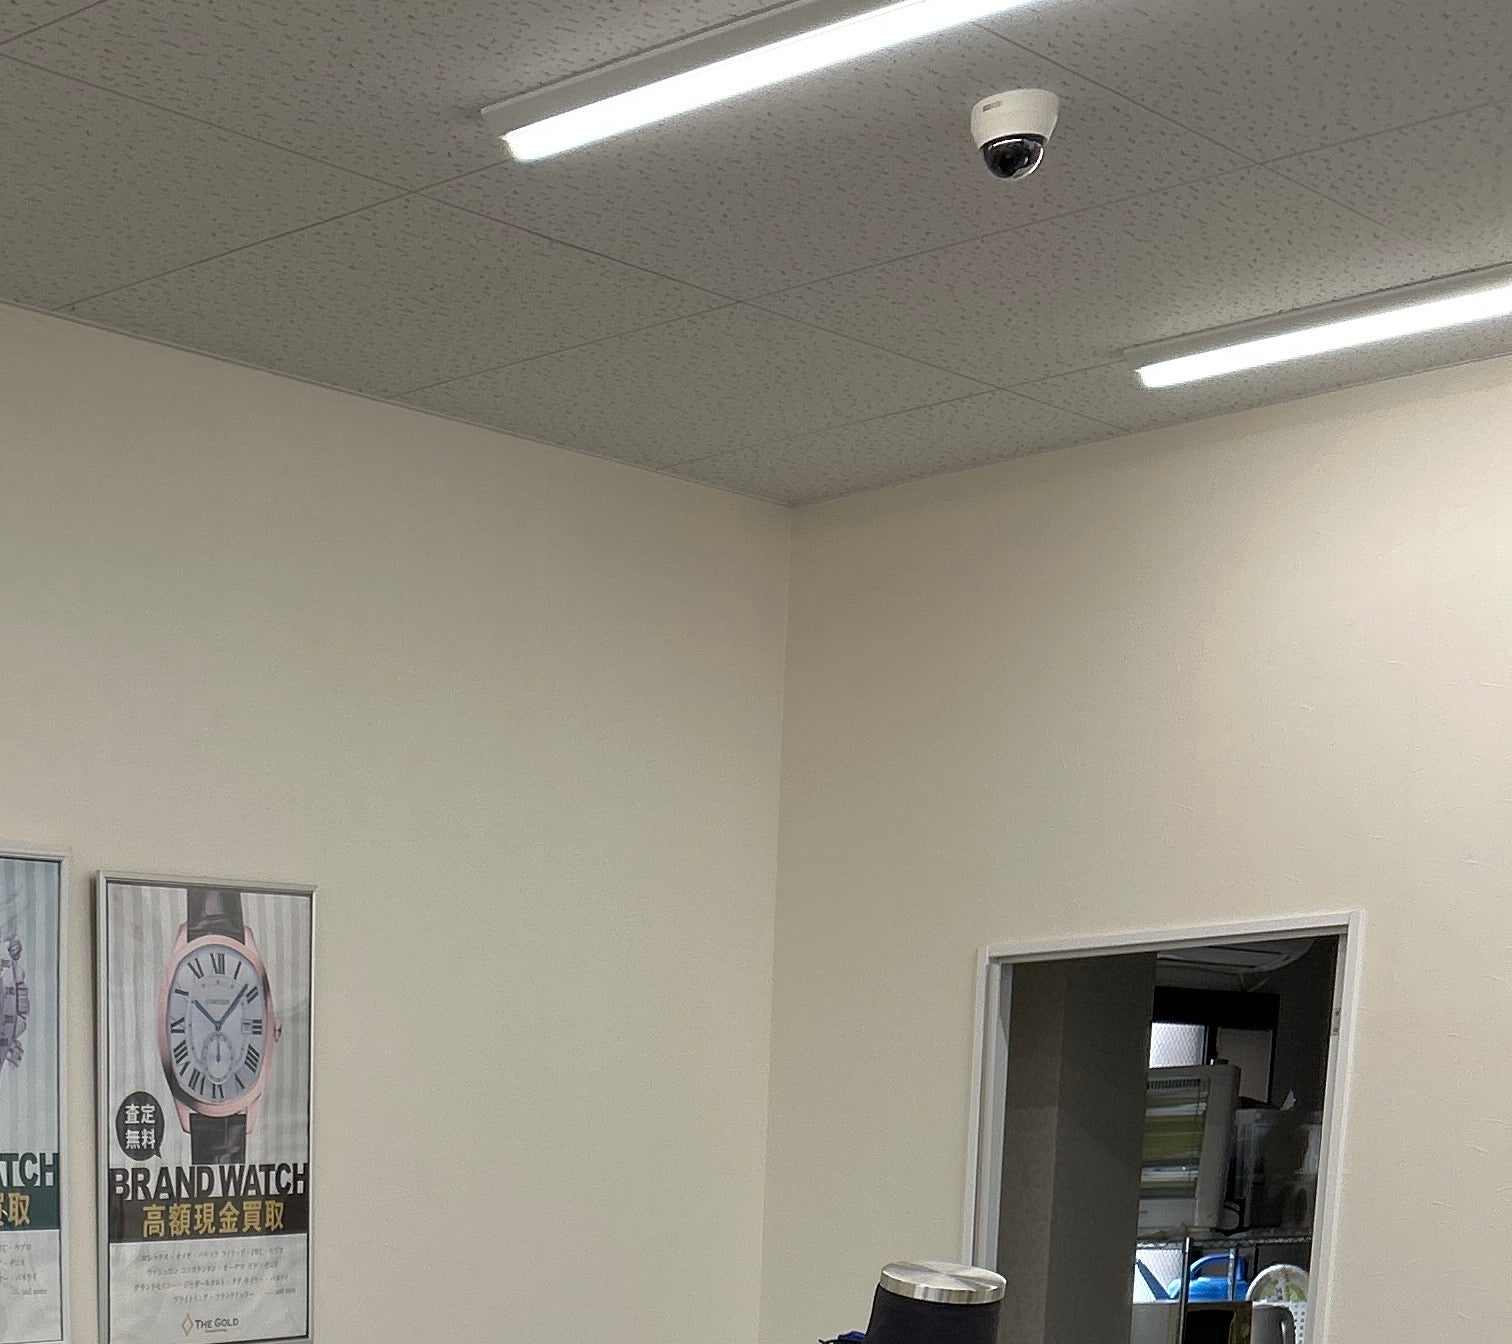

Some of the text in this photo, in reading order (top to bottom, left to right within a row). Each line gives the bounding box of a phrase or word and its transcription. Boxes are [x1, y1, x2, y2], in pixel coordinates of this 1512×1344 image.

[125, 1103, 155, 1124] 査定
[125, 1129, 156, 1150] 無料
[108, 1162, 309, 1200] BRAND WATCH
[142, 1200, 285, 1238] 高額現金買取
[195, 1316, 238, 1329] THE GOLD
